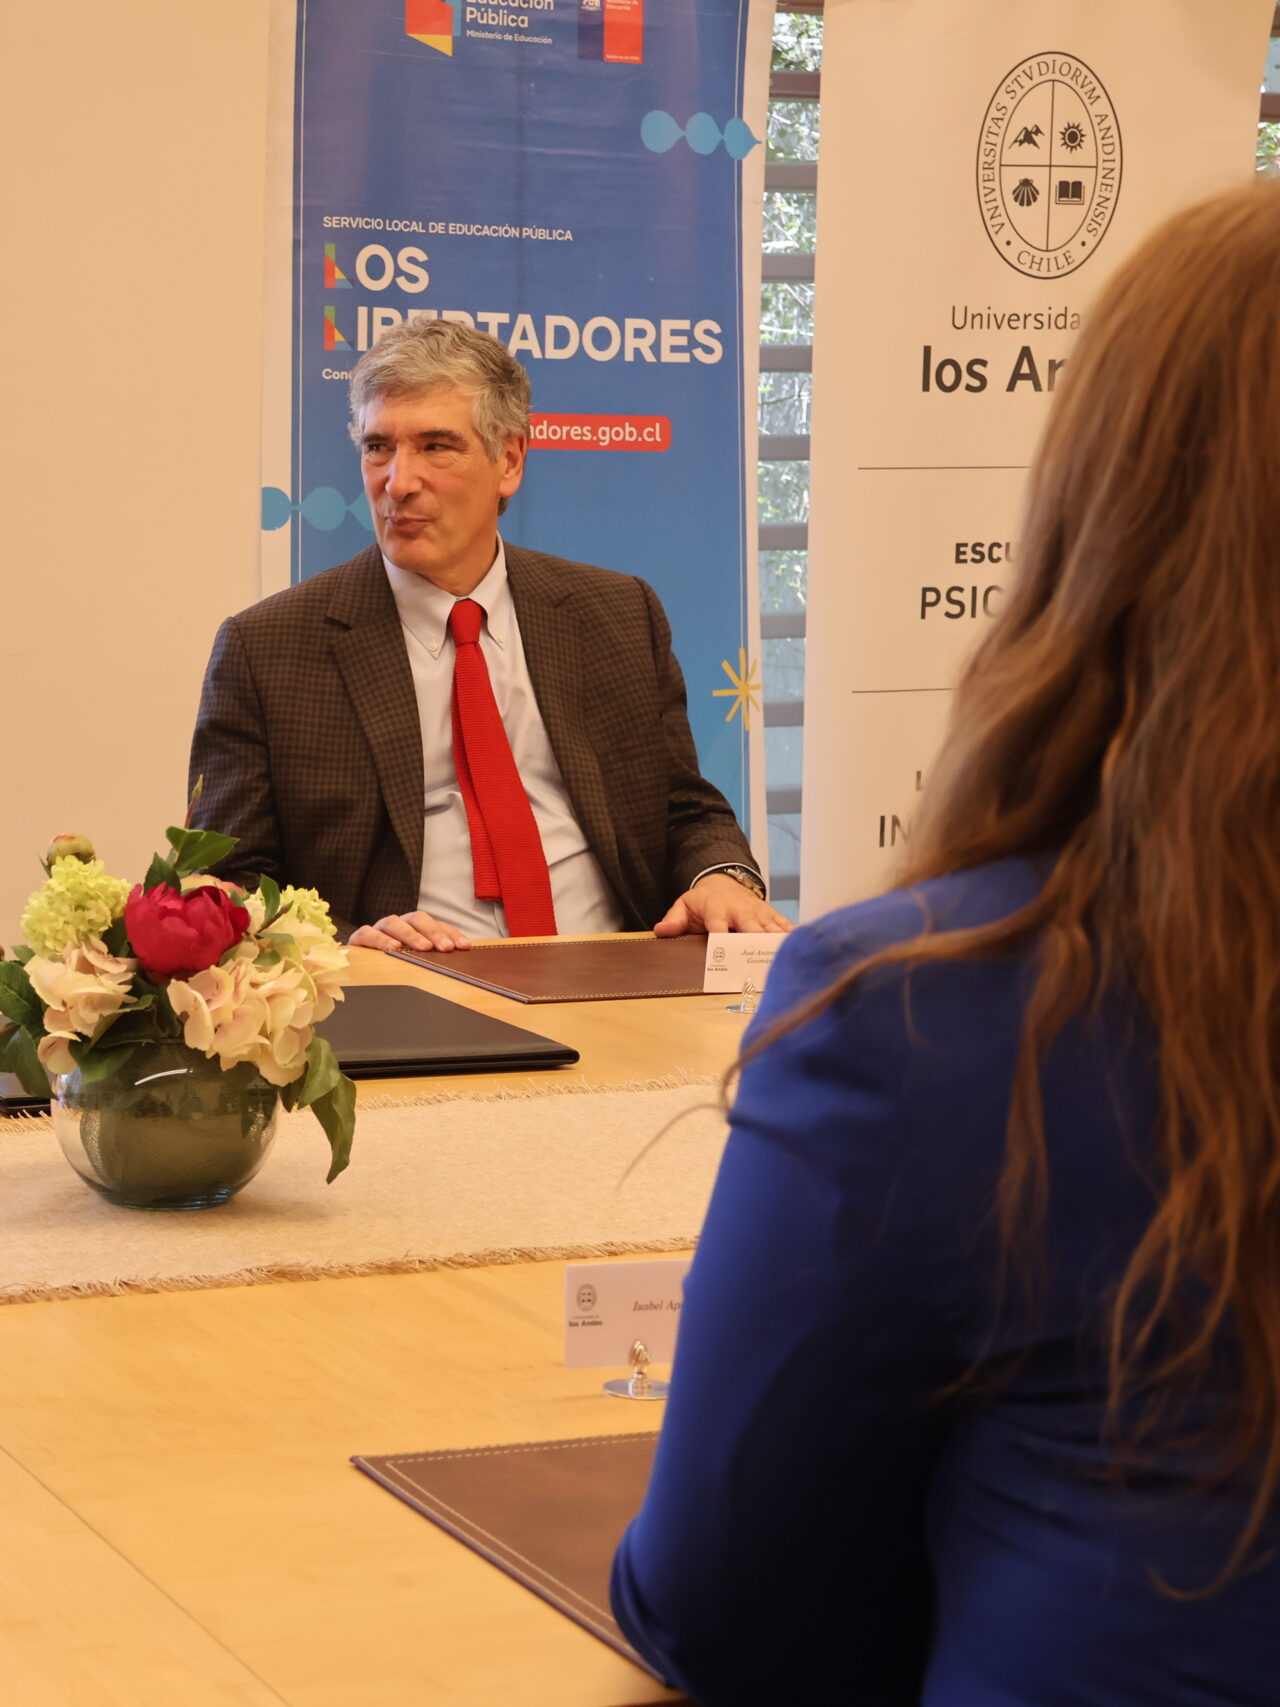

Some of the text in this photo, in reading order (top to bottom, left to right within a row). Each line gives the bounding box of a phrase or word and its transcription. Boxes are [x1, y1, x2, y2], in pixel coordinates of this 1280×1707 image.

[465, 7, 529, 28] Pública
[466, 30, 502, 40] Ministerio
[514, 33, 553, 44] Educación
[982, 59, 1116, 238] VNIVERSITAS STVDIORVM ANDINENSIS
[322, 216, 574, 241] SERVICIO LOCAL DE EDUCACIÓN PÚBLICA
[324, 243, 430, 294] LOS
[1017, 250, 1075, 273] CHILE
[922, 346, 988, 393] los
[632, 1300, 663, 1312] Isabel
